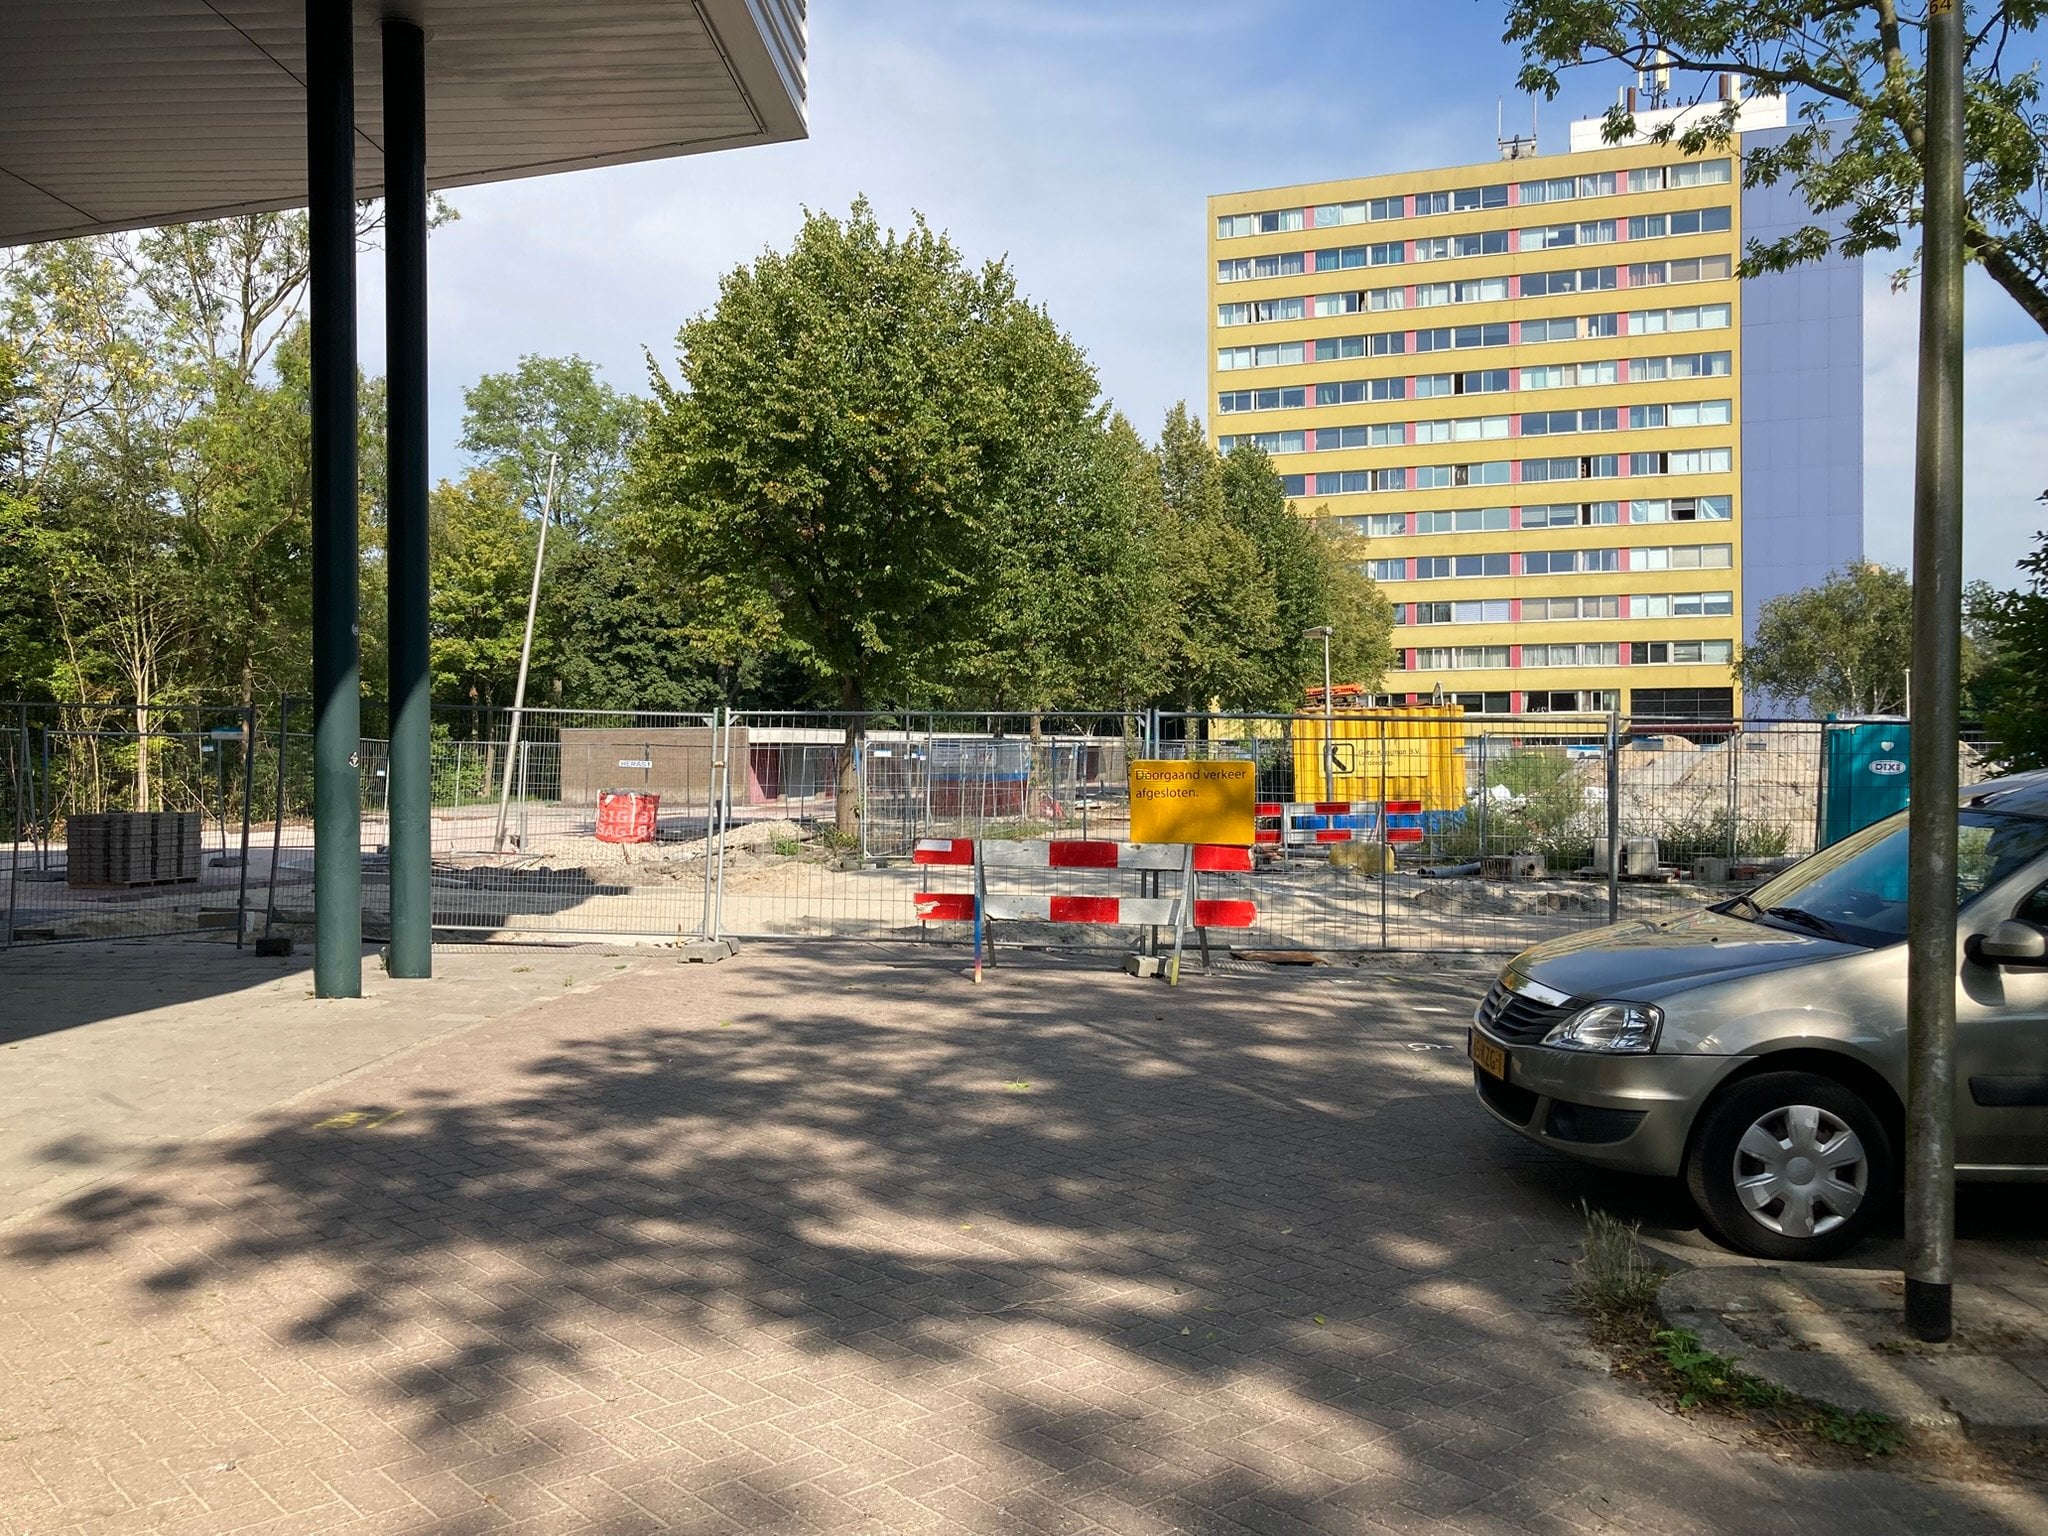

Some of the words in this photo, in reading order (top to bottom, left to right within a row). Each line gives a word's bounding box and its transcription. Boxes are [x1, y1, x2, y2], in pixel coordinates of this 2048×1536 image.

[1930, 0, 1952, 14] 64
[1135, 769, 1200, 782] Doorgaand
[1203, 769, 1247, 780] verkeer
[1135, 787, 1199, 800] afgesloten.
